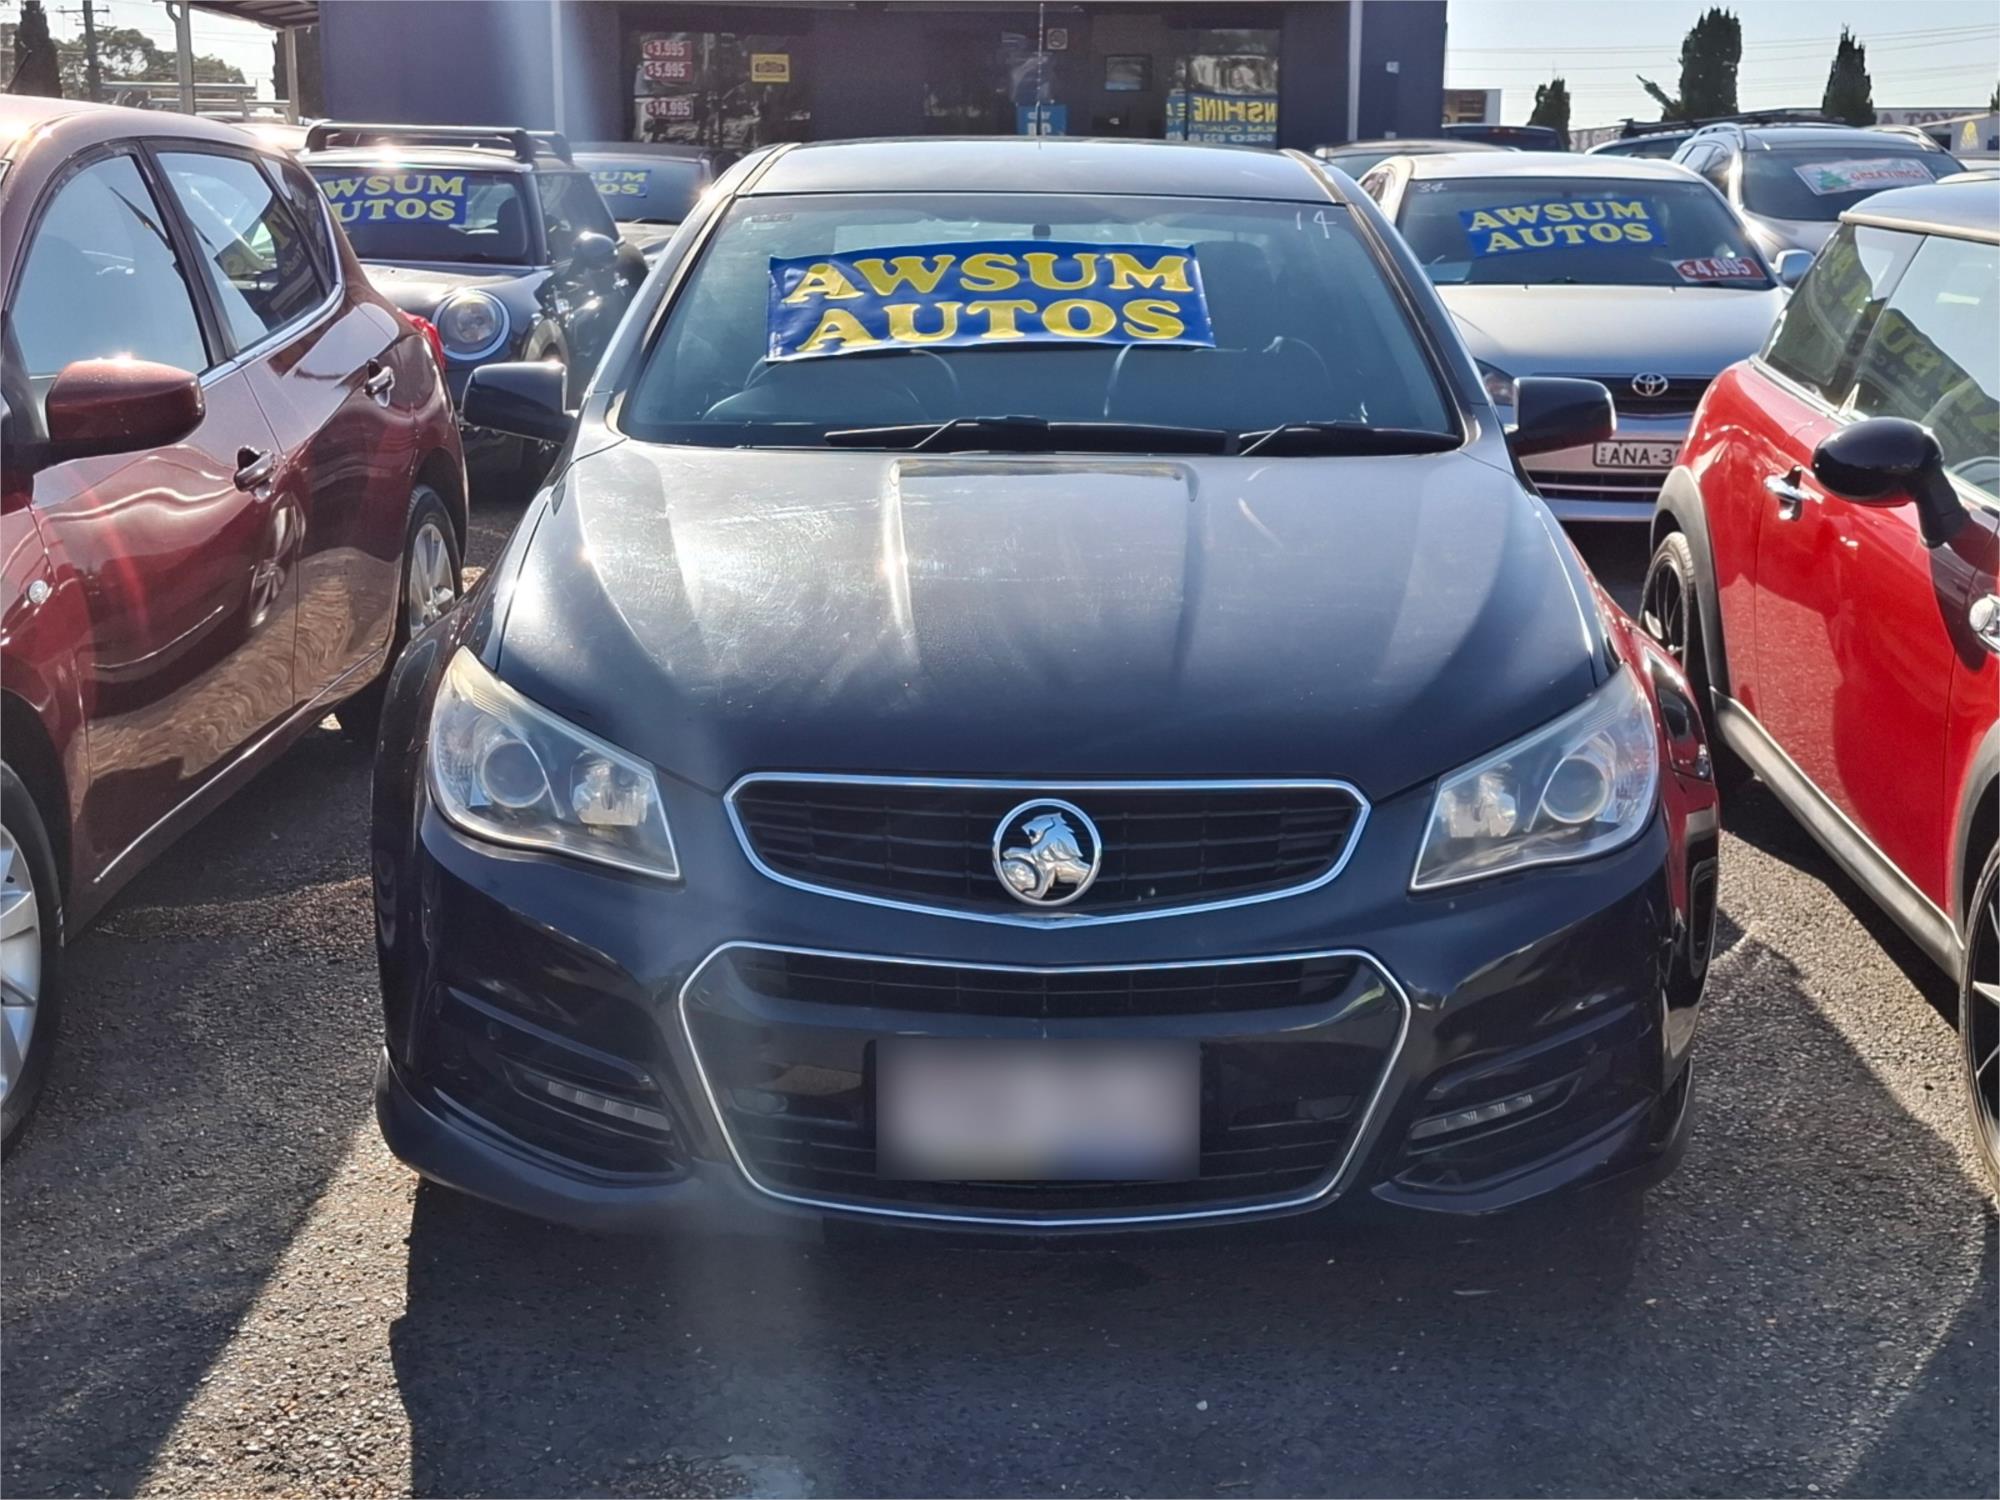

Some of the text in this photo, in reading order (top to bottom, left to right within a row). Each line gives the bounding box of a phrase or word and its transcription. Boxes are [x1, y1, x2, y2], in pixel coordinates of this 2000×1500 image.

[1296, 210, 1337, 239] 14
[1469, 202, 1650, 231] AWSUM
[1486, 223, 1653, 252] AUTOS
[781, 252, 1195, 304] AWSUM
[1681, 259, 1751, 277] $4,995
[796, 299, 1186, 352] AUTOS
